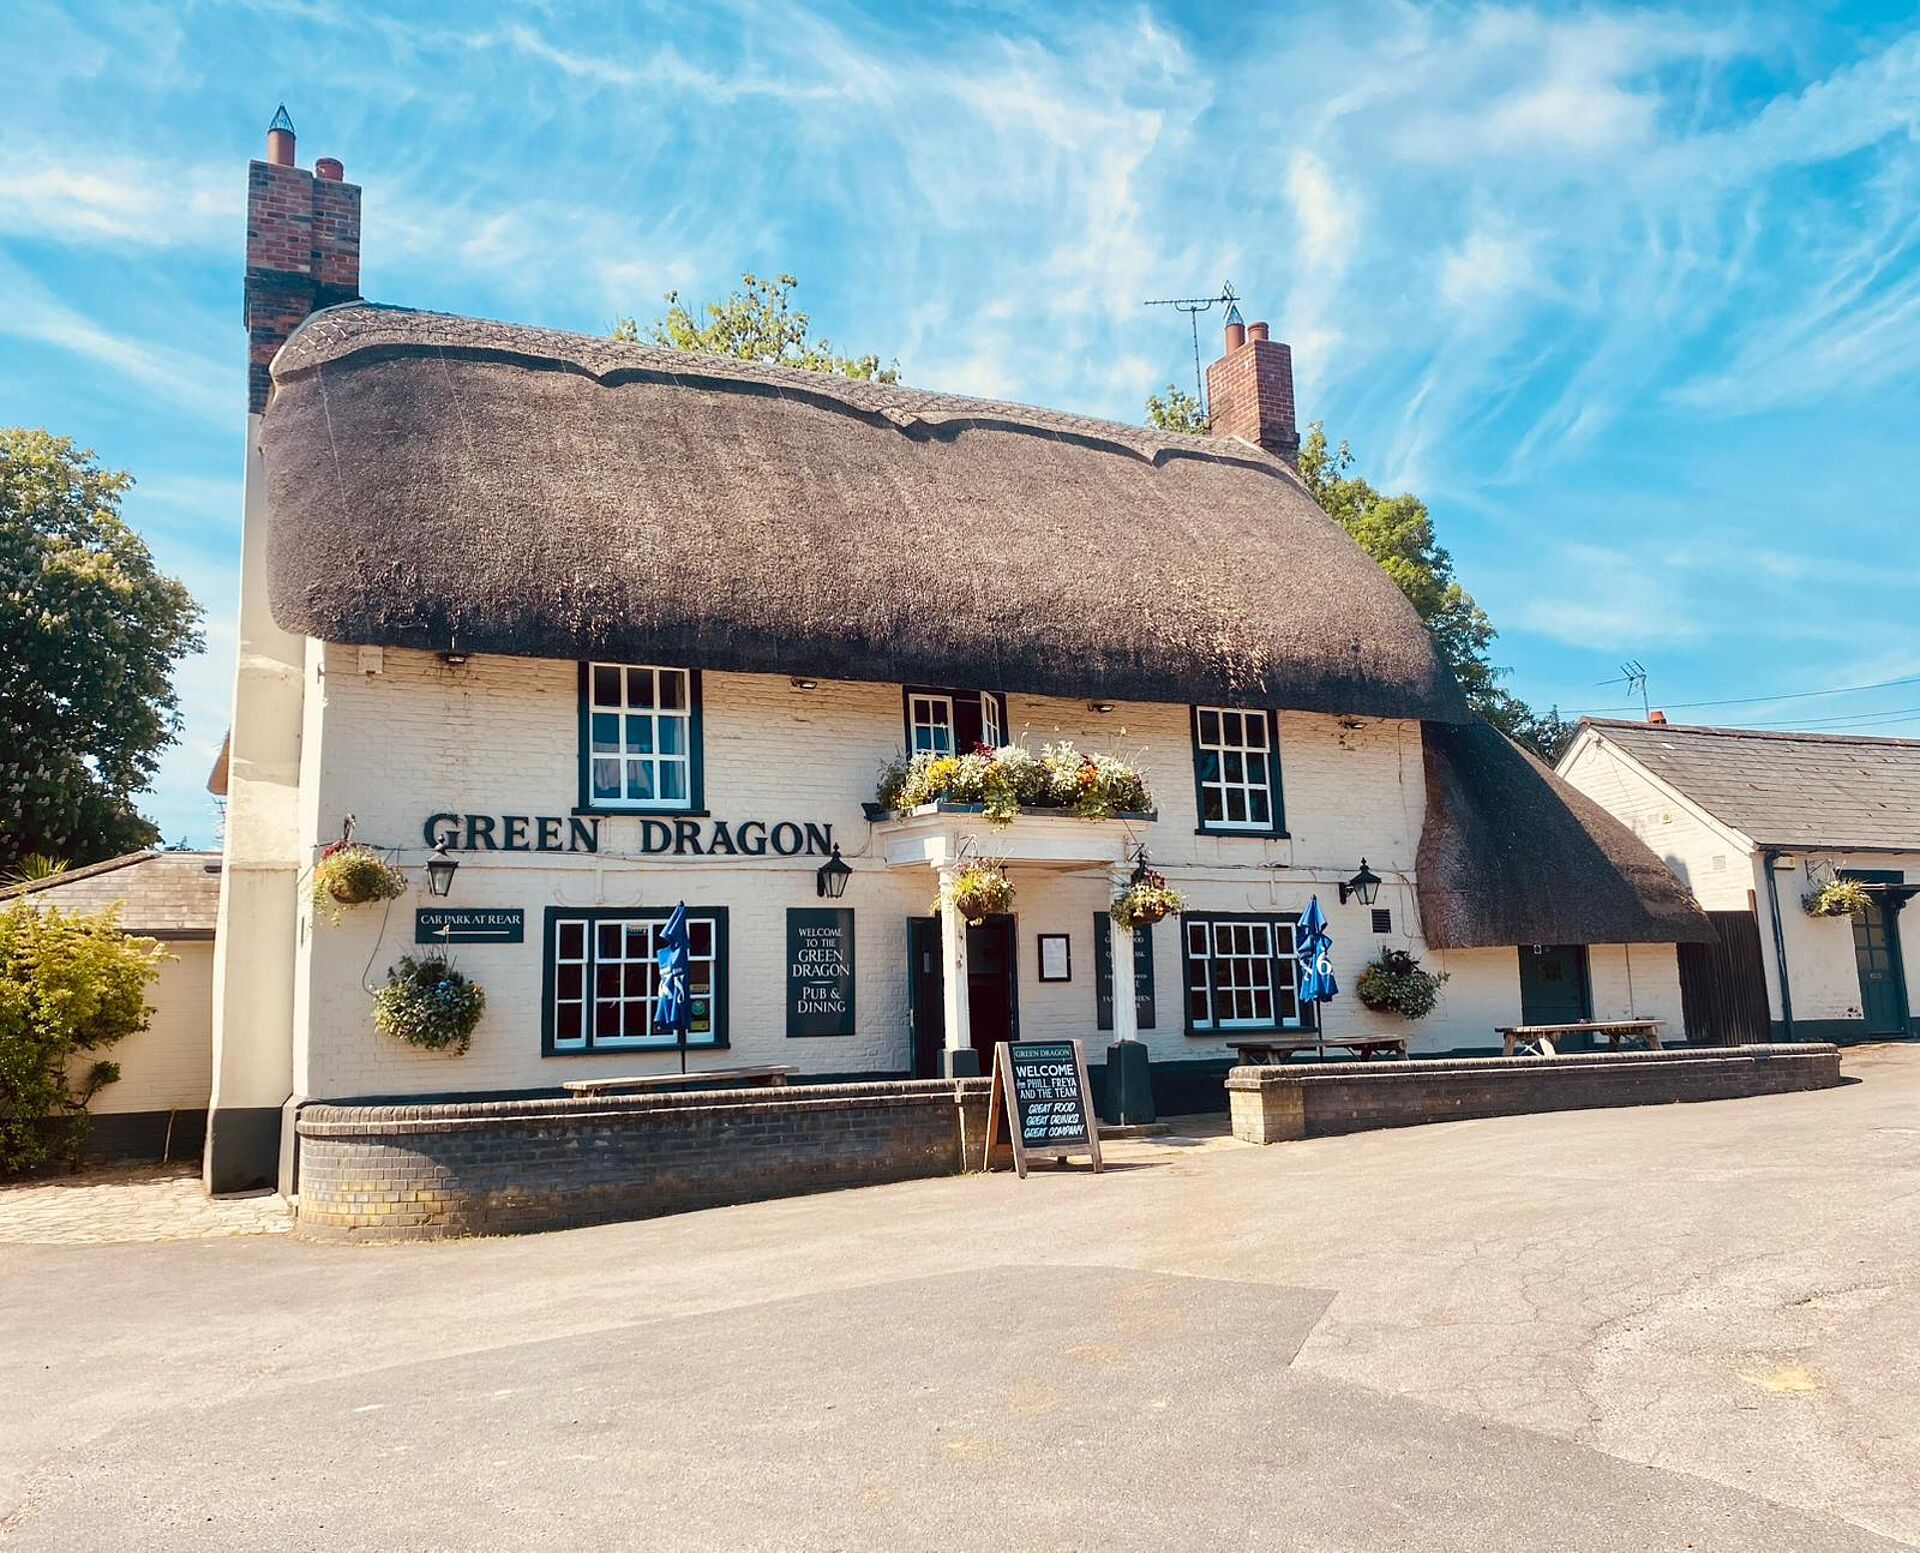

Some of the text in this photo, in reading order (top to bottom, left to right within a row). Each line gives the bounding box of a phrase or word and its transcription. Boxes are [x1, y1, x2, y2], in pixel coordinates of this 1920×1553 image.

[423, 813, 832, 856] GREEN DRAGON
[420, 914, 521, 925] CAR PARK AT REAR
[798, 927, 844, 937] WELCOME
[806, 938, 837, 948] TO THE
[798, 948, 843, 963] GREEN
[792, 963, 850, 978] DRAGON
[803, 986, 841, 1000] PUB &
[797, 1000, 846, 1014] DINING
[1040, 1049, 1070, 1057] DRAGON
[1016, 1064, 1074, 1077] WELCOME
[1051, 1077, 1077, 1087] FREYA
[1020, 1087, 1077, 1099] AND THE TEAM
[1028, 1102, 1076, 1114] GREAT FOOD
[1026, 1113, 1079, 1126] GREAT DRINKS
[1024, 1125, 1085, 1138] GREAT COMPANY
